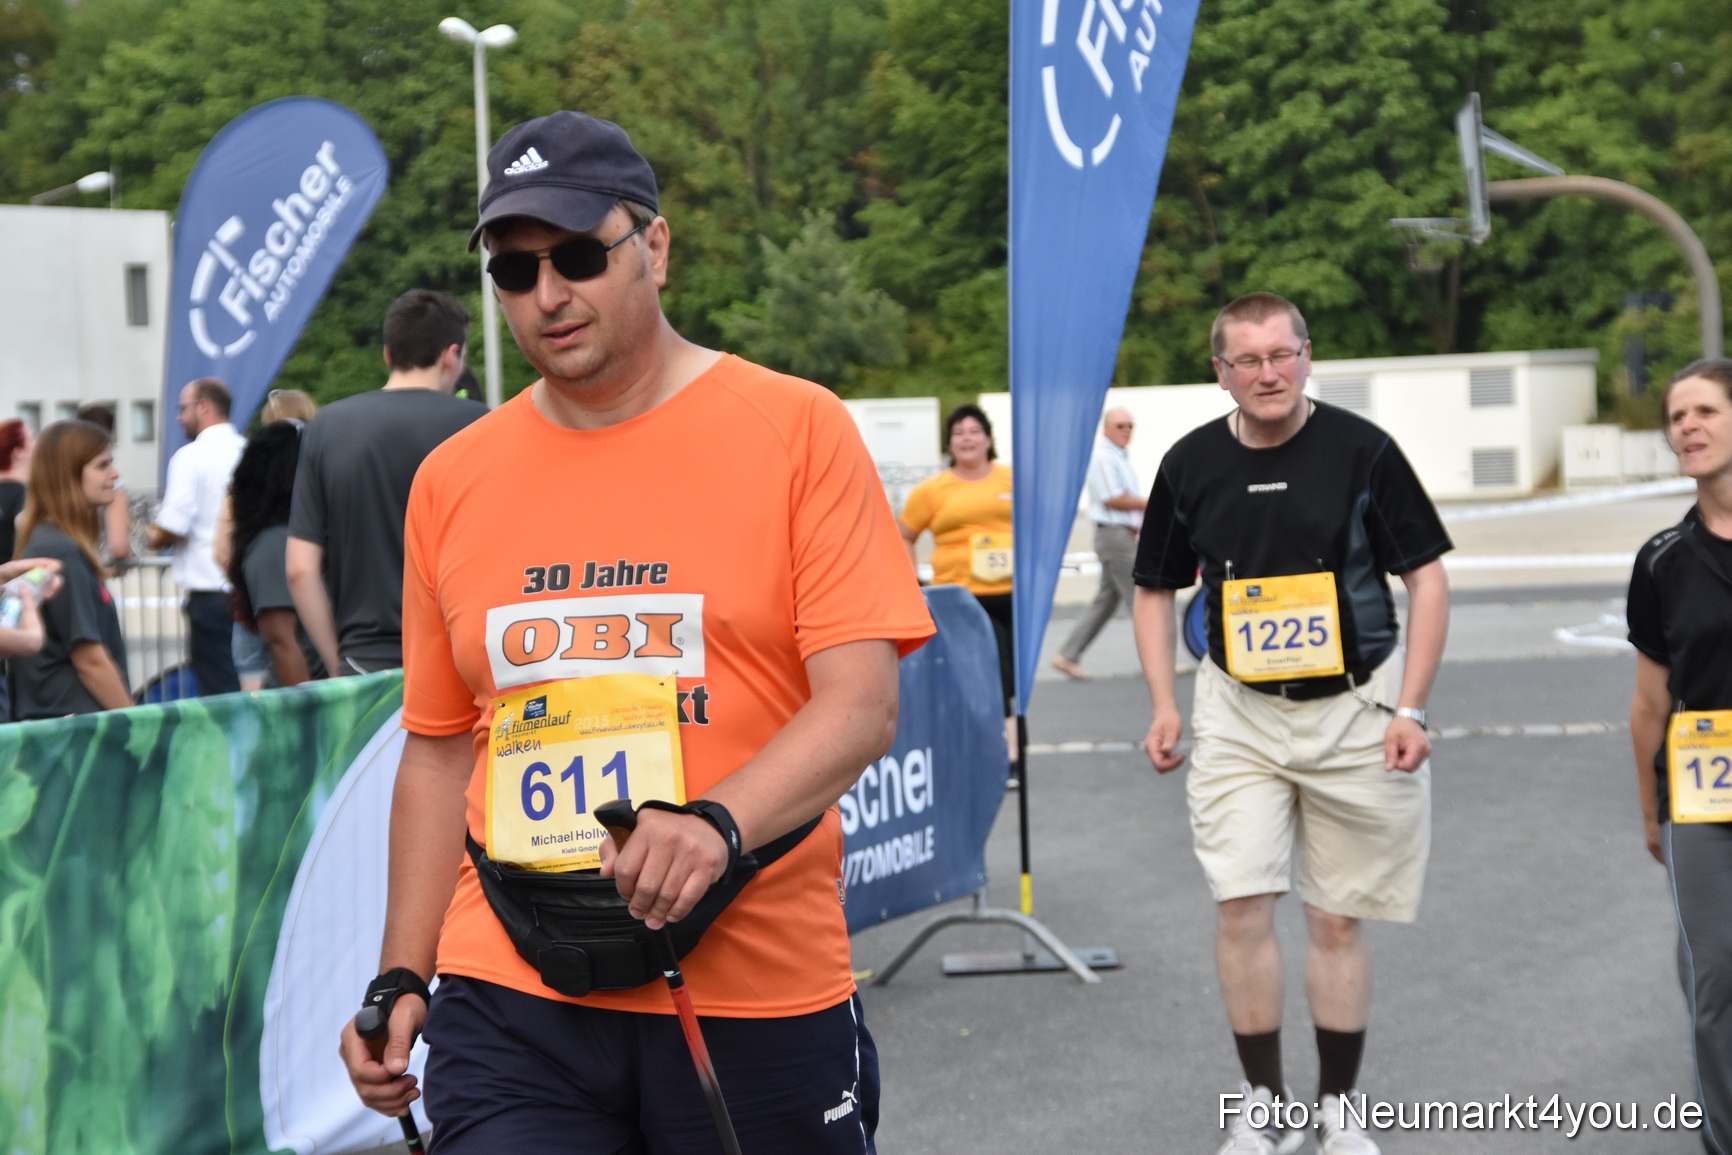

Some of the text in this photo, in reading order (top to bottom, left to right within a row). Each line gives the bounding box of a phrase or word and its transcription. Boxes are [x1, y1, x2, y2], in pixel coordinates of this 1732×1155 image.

[504, 160, 549, 175] adidas
[218, 140, 341, 327] Fischer
[263, 174, 353, 323] AUTOMOBILE
[522, 559, 669, 594] 30 Jahre
[502, 613, 684, 666] OBI
[1238, 616, 1329, 652] 1225
[496, 739, 541, 757] walken
[521, 750, 630, 821] 611
[531, 830, 574, 847] Michael
[578, 844, 598, 852] GmbH
[824, 1098, 854, 1125] PUMA
